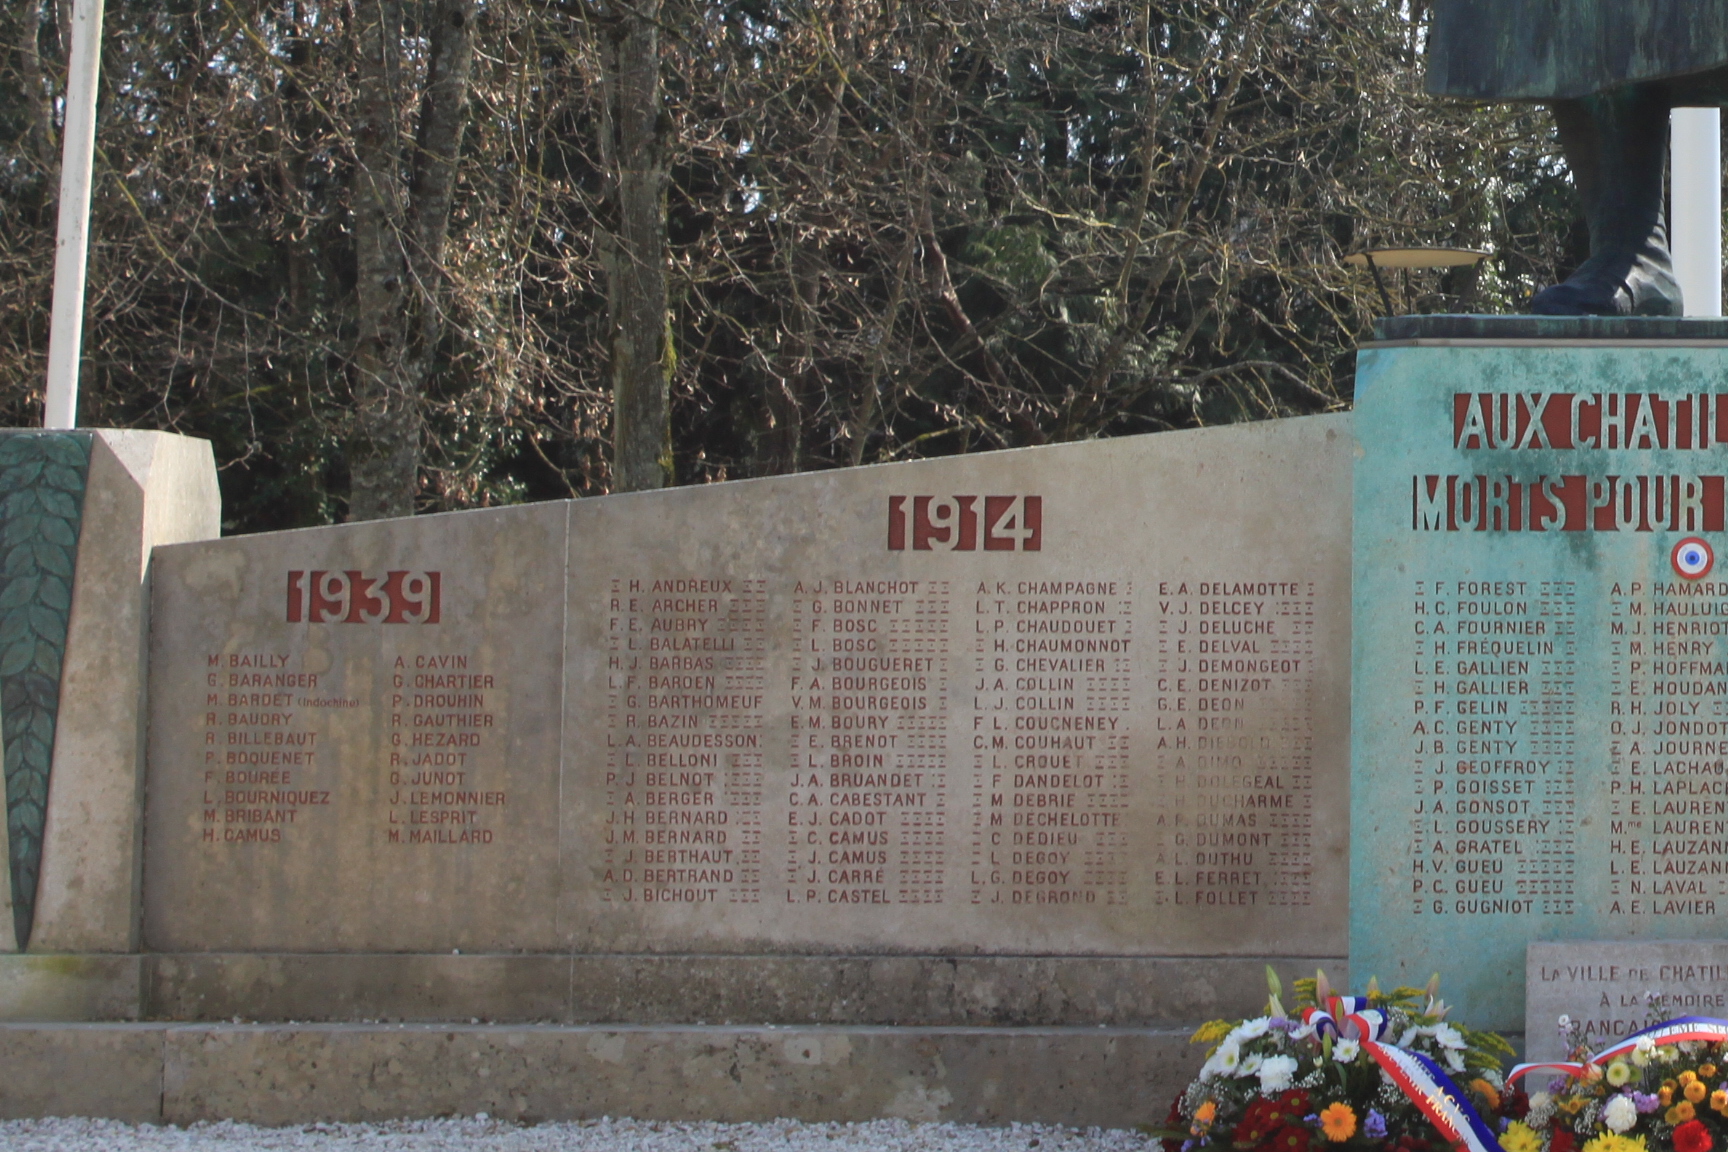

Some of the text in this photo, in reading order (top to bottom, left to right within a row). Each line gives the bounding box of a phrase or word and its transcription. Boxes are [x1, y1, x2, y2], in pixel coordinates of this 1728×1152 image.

[1457, 392, 1554, 450] AUX
[1416, 475, 1567, 532] MORTS
[1588, 475, 1703, 532] POUR
[895, 495, 1036, 551] 1914
[651, 579, 732, 592] ANDREUX
[832, 581, 919, 594] BLANCHOT
[1017, 582, 1116, 594] CHAMPAGNE
[1199, 582, 1298, 595] DELAMOTTE
[1457, 581, 1527, 596] FOREST
[294, 569, 434, 625] 1939
[651, 599, 718, 612] ARCHER
[833, 600, 903, 614] BONNET
[1456, 601, 1527, 615] FOULON
[1457, 621, 1545, 634] FOURNIER
[1198, 640, 1259, 653] DELVAL
[1456, 638, 1553, 657] FRÉQUELIN
[229, 654, 290, 668] BAILLY
[649, 656, 715, 670] BARBAS
[1015, 658, 1104, 671] CHEVALIER
[1198, 660, 1300, 673] DEMONGEOT
[1456, 661, 1528, 675] GALLIEN
[228, 673, 318, 687] BARANGER
[414, 674, 494, 688] CHARTIER
[831, 677, 926, 690] BOURGEOIS
[1015, 678, 1074, 691] COLLIN
[227, 693, 293, 706] BARDET
[413, 694, 484, 707] DROUHIN
[1456, 700, 1507, 714] GELIN
[413, 714, 493, 727] GAUTHIER
[227, 732, 317, 745] BILLEBAUT
[412, 733, 480, 746] HEZARD
[226, 751, 315, 765] BOQUENET
[1455, 760, 1550, 774] GEOFFROY
[224, 791, 330, 805] BOURNIQUEZ
[410, 792, 506, 805] LEMONNIER
[645, 791, 713, 805] BERGER
[829, 793, 926, 806] CABESTANT
[645, 811, 728, 824] BERNARD
[1455, 820, 1550, 834] GOUSSERY
[408, 829, 493, 844] MAILLARD
[643, 869, 733, 883] BERTRAND
[827, 889, 890, 904] CASTEL
[1455, 900, 1532, 914] GUGNIOT
[1567, 966, 1618, 981] VILLE
[1621, 995, 1638, 1007] LA
